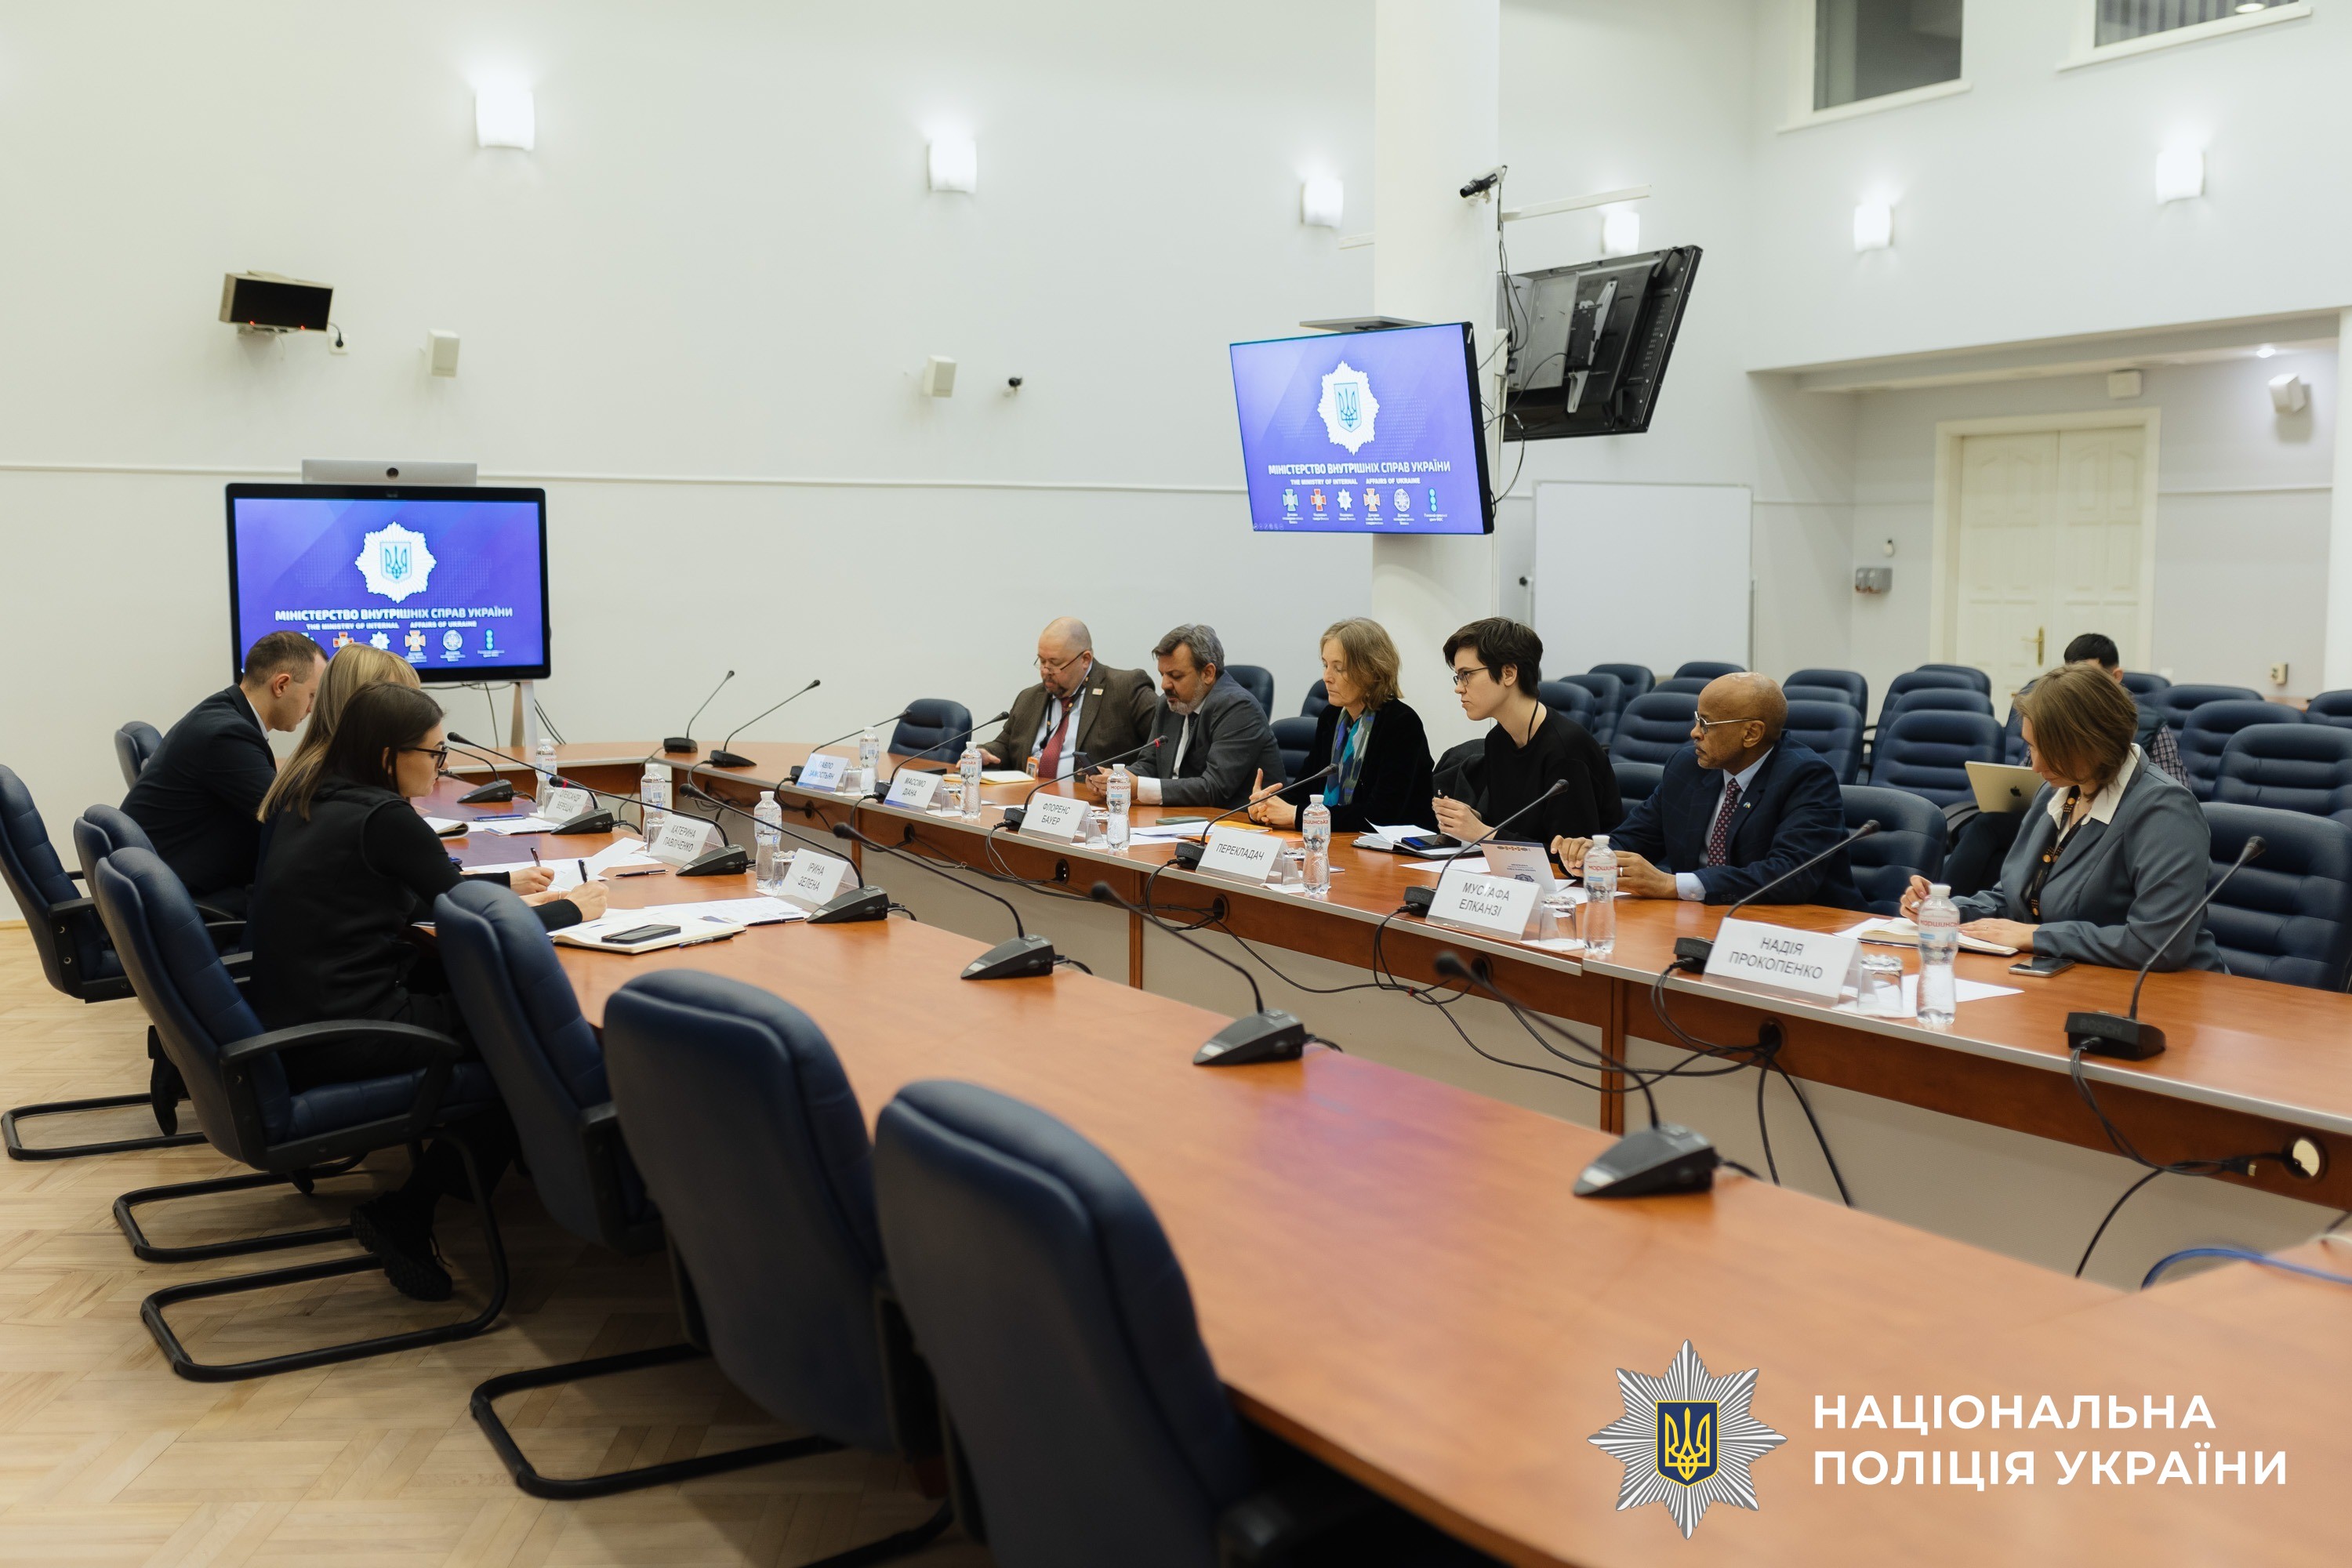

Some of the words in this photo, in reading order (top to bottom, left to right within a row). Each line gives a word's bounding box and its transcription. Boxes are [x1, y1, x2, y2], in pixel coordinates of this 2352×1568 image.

[1268, 463, 1327, 475] МІНІСТЕРСТВО
[1327, 463, 1380, 474] ВНУТРІШНІХ
[1381, 462, 1410, 473] СПРАВ
[1411, 459, 1450, 472] УКРАЇНИ
[275, 609, 359, 621] МІНІСТЕРСТВО
[361, 608, 429, 620] ВНУТРІШНІХ
[431, 608, 466, 619] СПРАВ
[468, 605, 513, 618] УКРАЇНИ
[904, 777, 927, 788] МАССІМО
[902, 788, 917, 797] ДІАНА
[1042, 803, 1071, 815] ФЛОРЕНС
[1041, 815, 1061, 826] БАУЕР
[671, 825, 696, 839] КАТЕРИНА
[662, 837, 694, 852] ПАВЛІЧЕНКО
[1216, 843, 1265, 862] ПЕРЕКЛАДАЧ
[808, 862, 825, 876] ІРИНА
[798, 876, 820, 891] ЗЕЛЕНА
[1459, 899, 1502, 916] ЕЛКАНЗІ
[1759, 937, 1805, 956] НАДІЯ
[1728, 951, 1824, 979] ПРОКОПЕНКО
[2079, 1018, 2123, 1035] BOSCH
